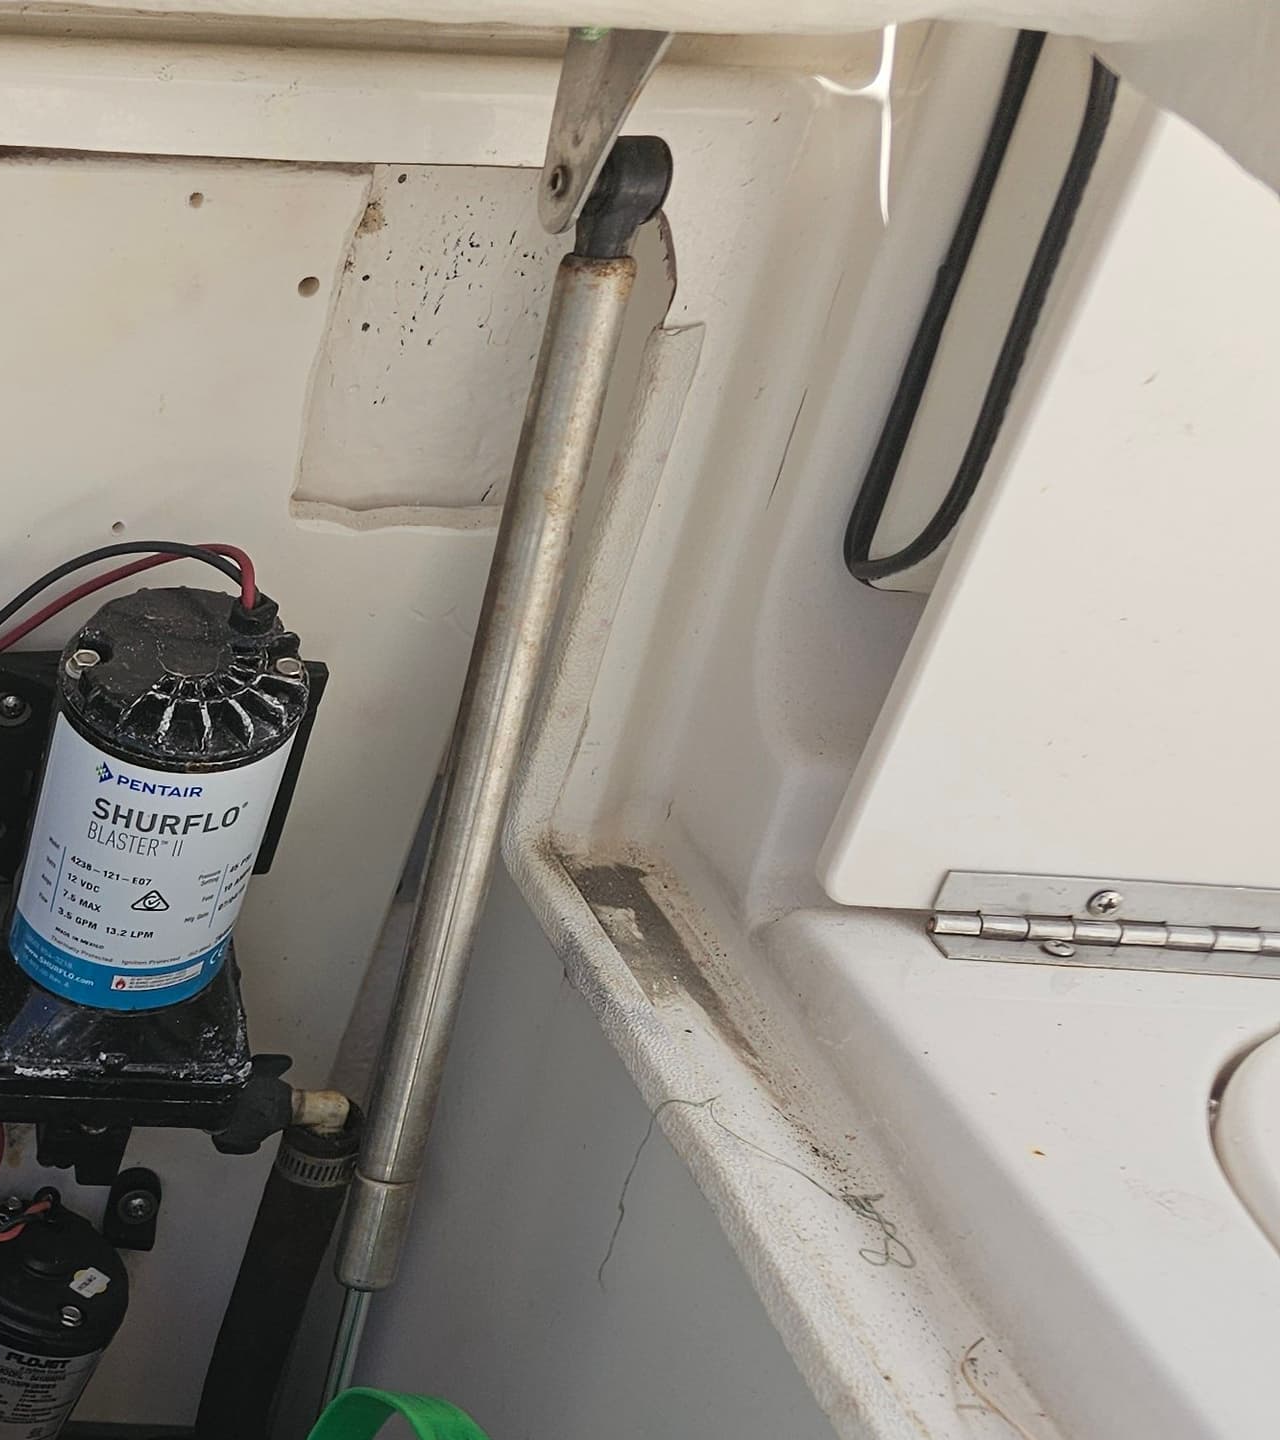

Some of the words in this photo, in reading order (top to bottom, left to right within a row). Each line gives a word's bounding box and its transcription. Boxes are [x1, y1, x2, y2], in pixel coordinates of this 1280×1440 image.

[116, 774, 203, 798] PENTAIR
[172, 839, 184, 857] II
[67, 872, 78, 883] 12
[80, 878, 101, 893] VDC
[63, 889, 77, 903] 7.5
[79, 897, 103, 913] MAX
[57, 907, 73, 920] 3.5
[75, 916, 98, 931] GPM
[105, 926, 128, 937] 13.2
[130, 930, 154, 939] LPM
